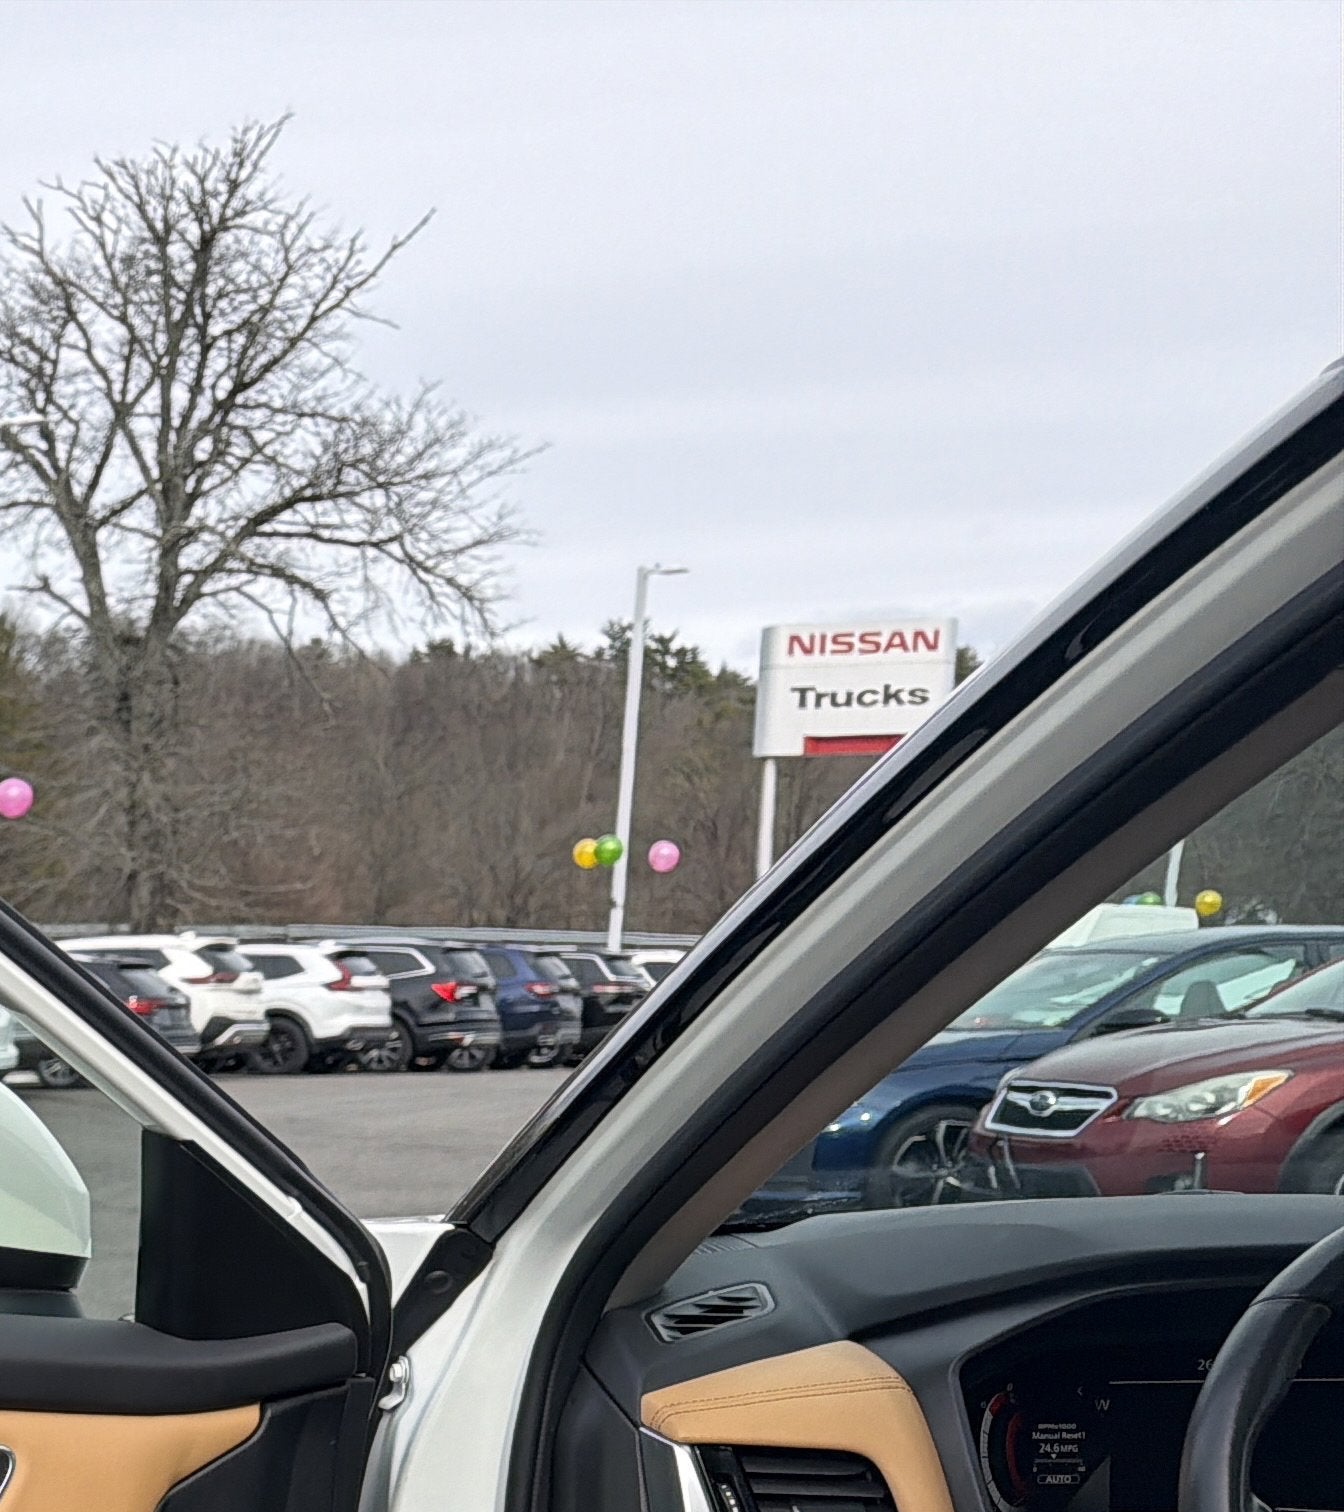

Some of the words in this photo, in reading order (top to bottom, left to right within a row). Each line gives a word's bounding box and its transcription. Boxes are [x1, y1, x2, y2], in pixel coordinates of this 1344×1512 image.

[788, 627, 940, 657] NISSAN
[790, 684, 930, 710] Trucks
[1032, 1431, 1060, 1440] Manual
[1039, 1442, 1060, 1454] 24.6
[1060, 1444, 1079, 1453] MPG
[1045, 1475, 1072, 1484] AUTO
